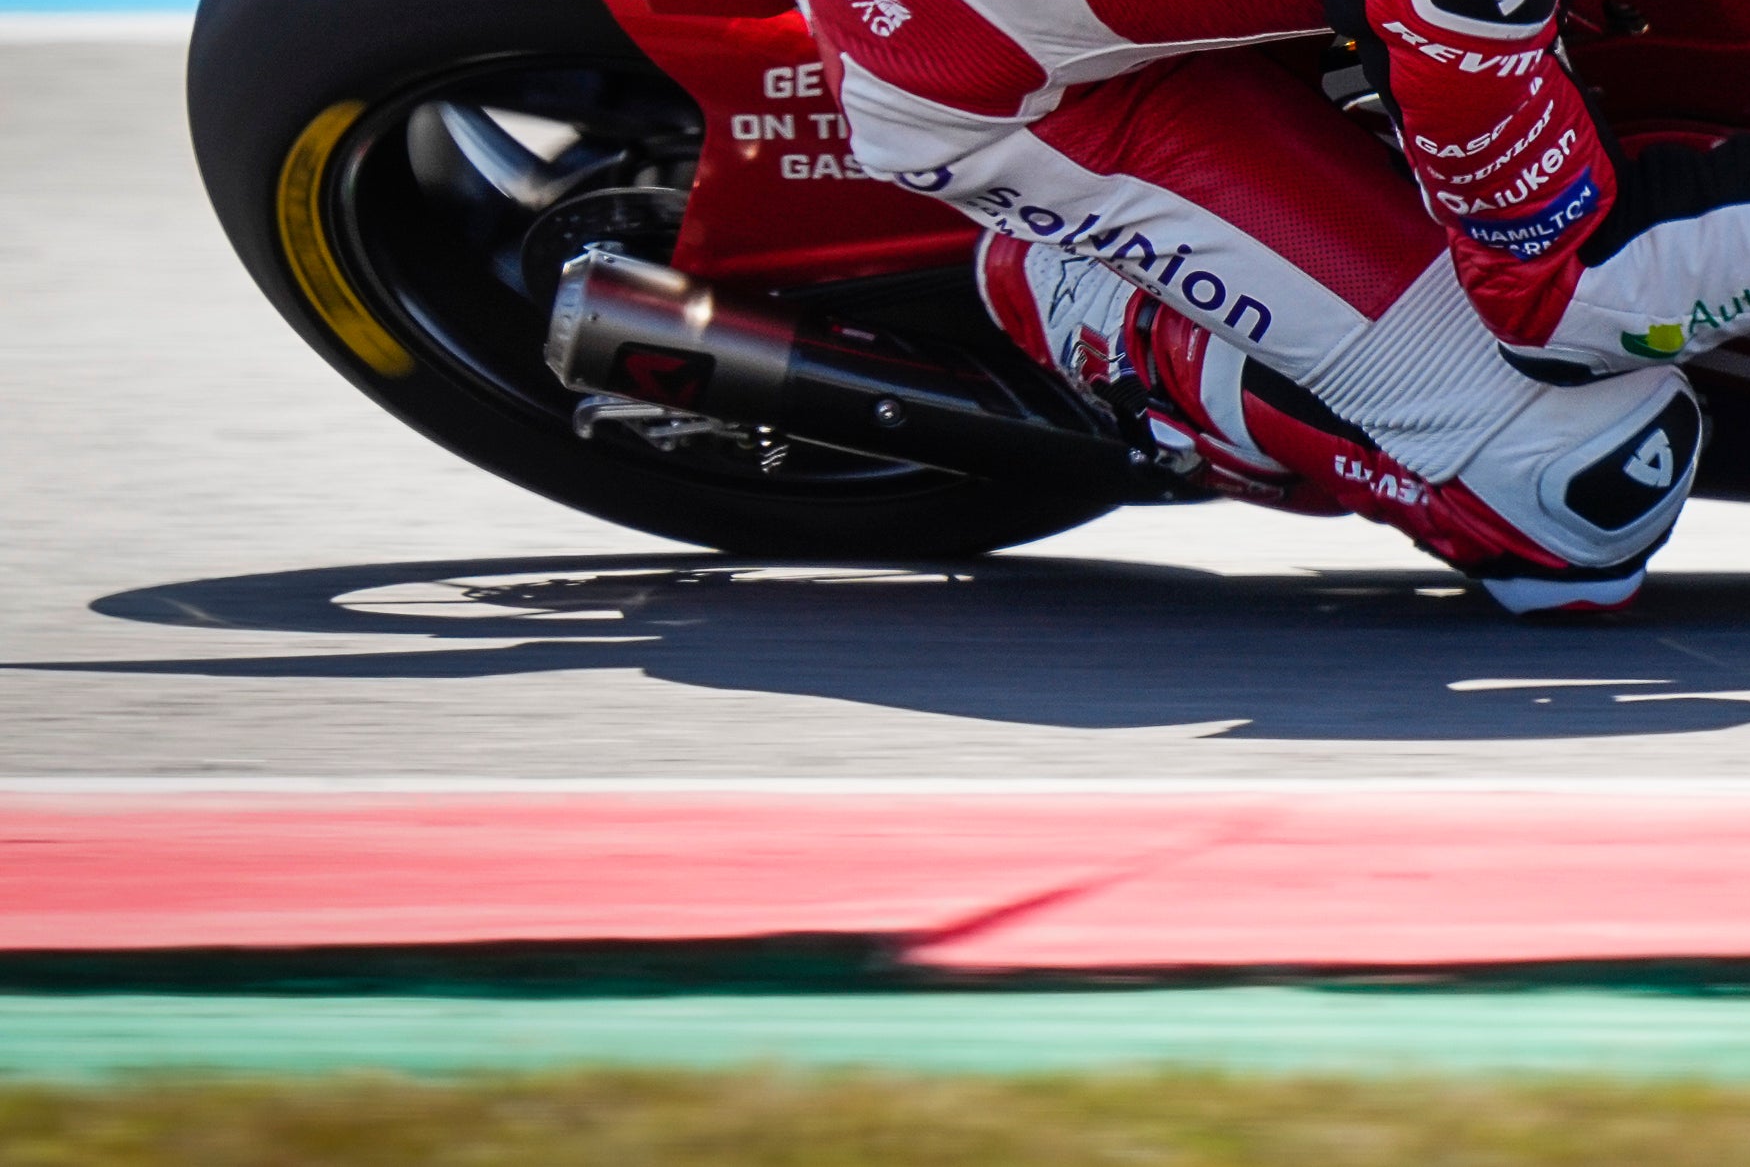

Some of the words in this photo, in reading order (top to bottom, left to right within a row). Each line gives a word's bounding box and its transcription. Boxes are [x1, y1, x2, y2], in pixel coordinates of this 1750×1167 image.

[763, 61, 825, 99] GE
[731, 114, 796, 140] ON
[1449, 99, 1554, 184] DUNLOP
[1471, 185, 1592, 243] HAMILTON
